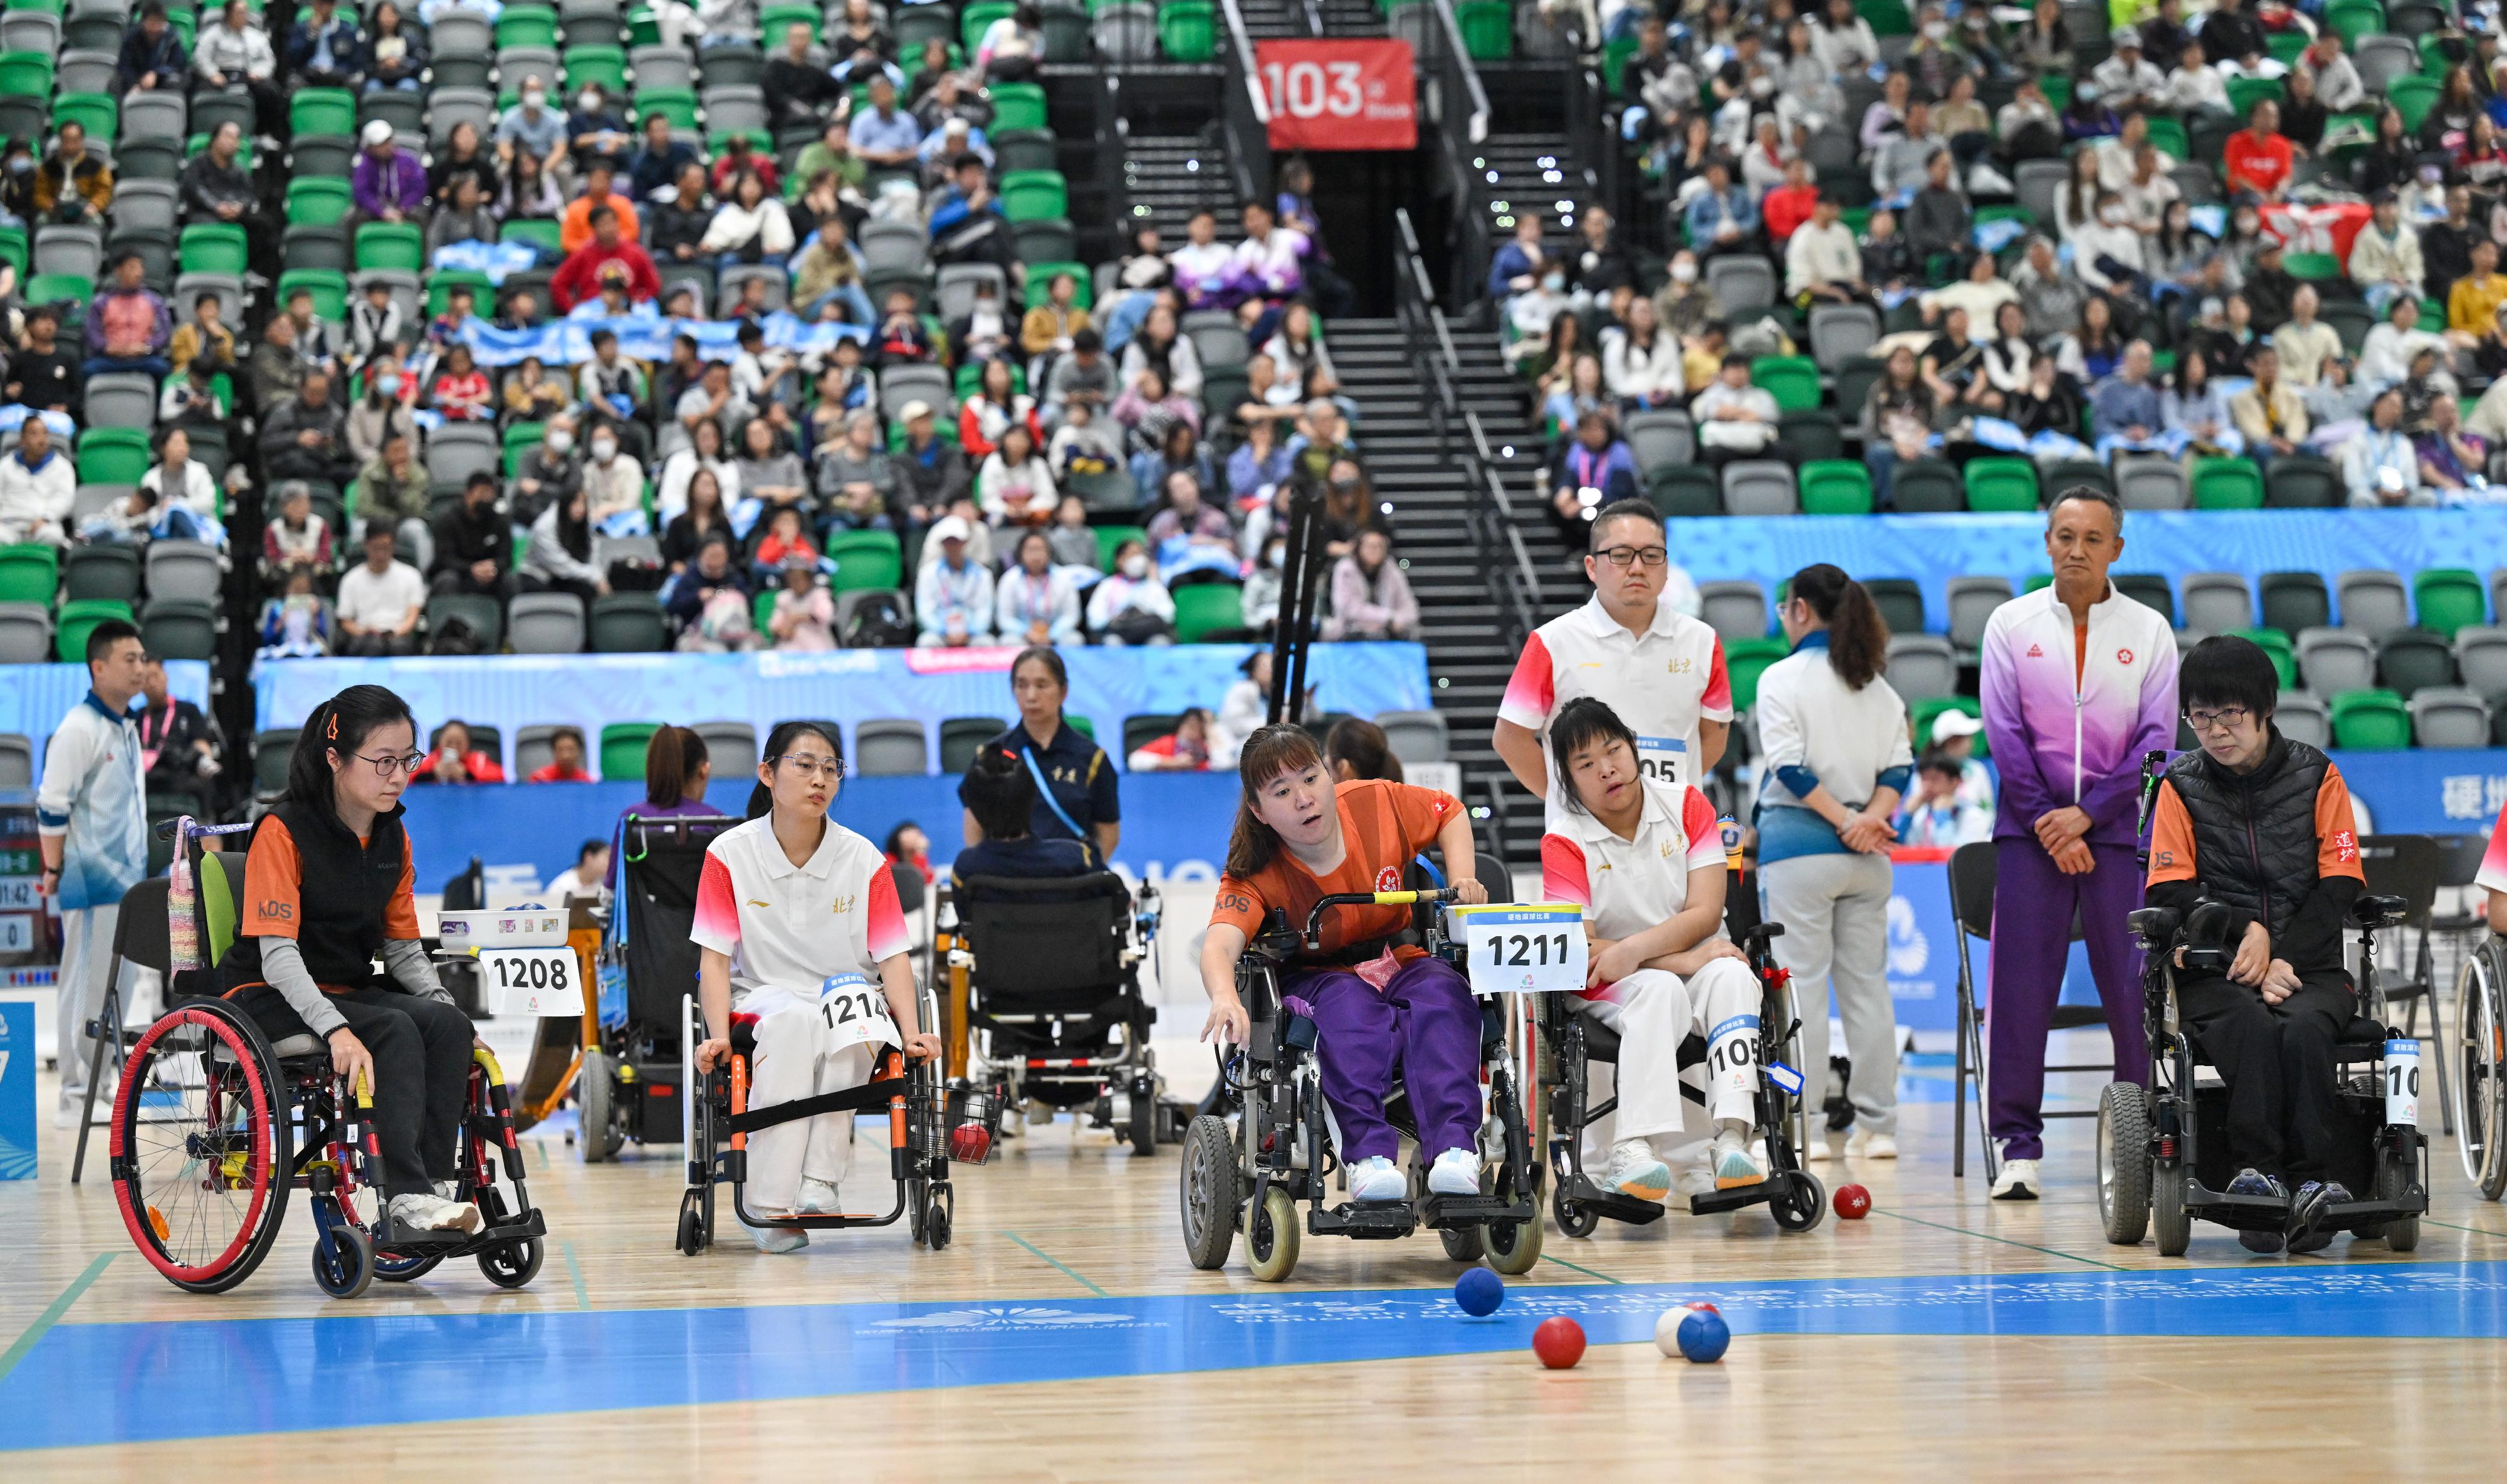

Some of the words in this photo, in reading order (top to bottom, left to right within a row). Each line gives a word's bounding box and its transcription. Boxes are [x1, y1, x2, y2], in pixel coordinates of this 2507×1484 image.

[1263, 61, 1363, 117] 103
[1668, 658, 1691, 674] 北京
[1662, 834, 1684, 857] 北京
[833, 895, 856, 914] 北京
[1488, 934, 1568, 966] 1211
[493, 958, 568, 990] 1208
[822, 993, 888, 1030] 1214
[1707, 1037, 1758, 1081] 1105
